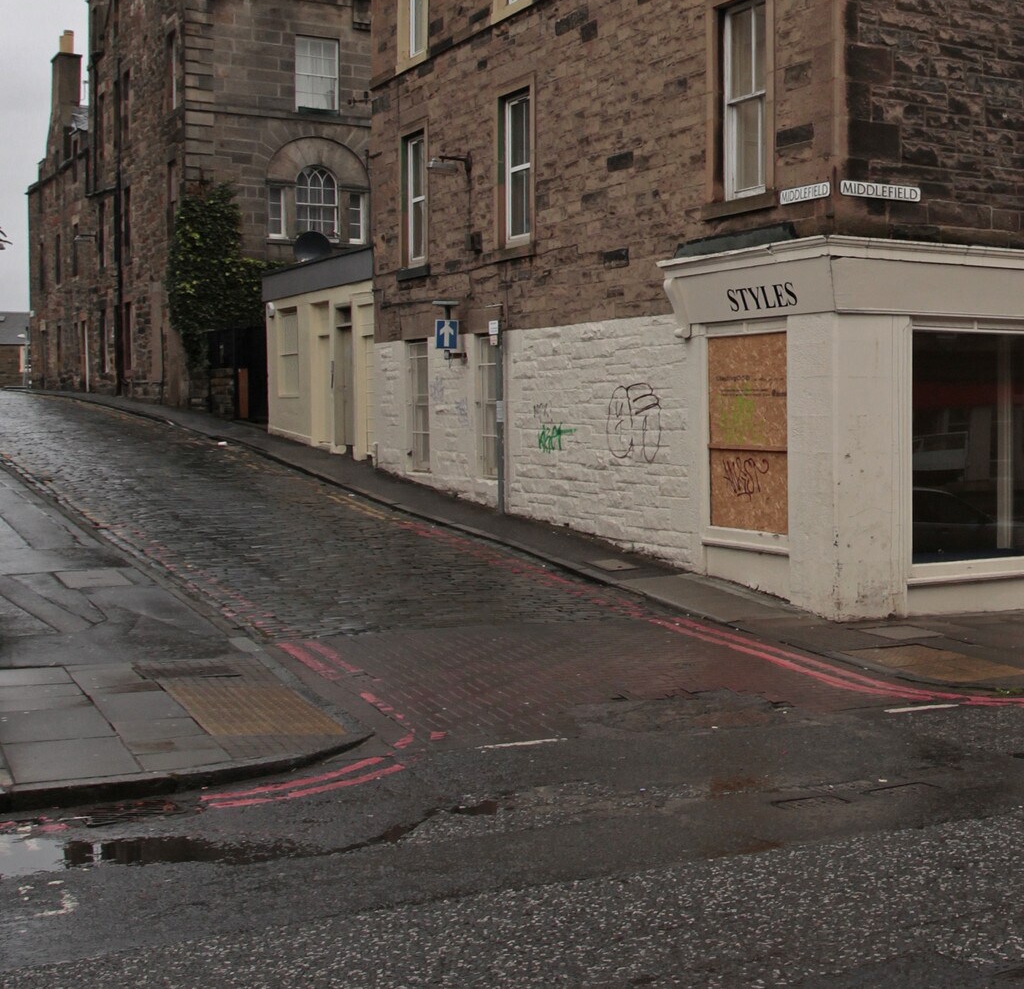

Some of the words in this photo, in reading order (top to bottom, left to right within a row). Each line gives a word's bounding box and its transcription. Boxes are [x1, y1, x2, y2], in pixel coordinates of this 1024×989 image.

[781, 183, 829, 203] MIDDLEFIELD
[843, 181, 918, 200] MIDDLEFIELD
[726, 281, 798, 312] STYLES
